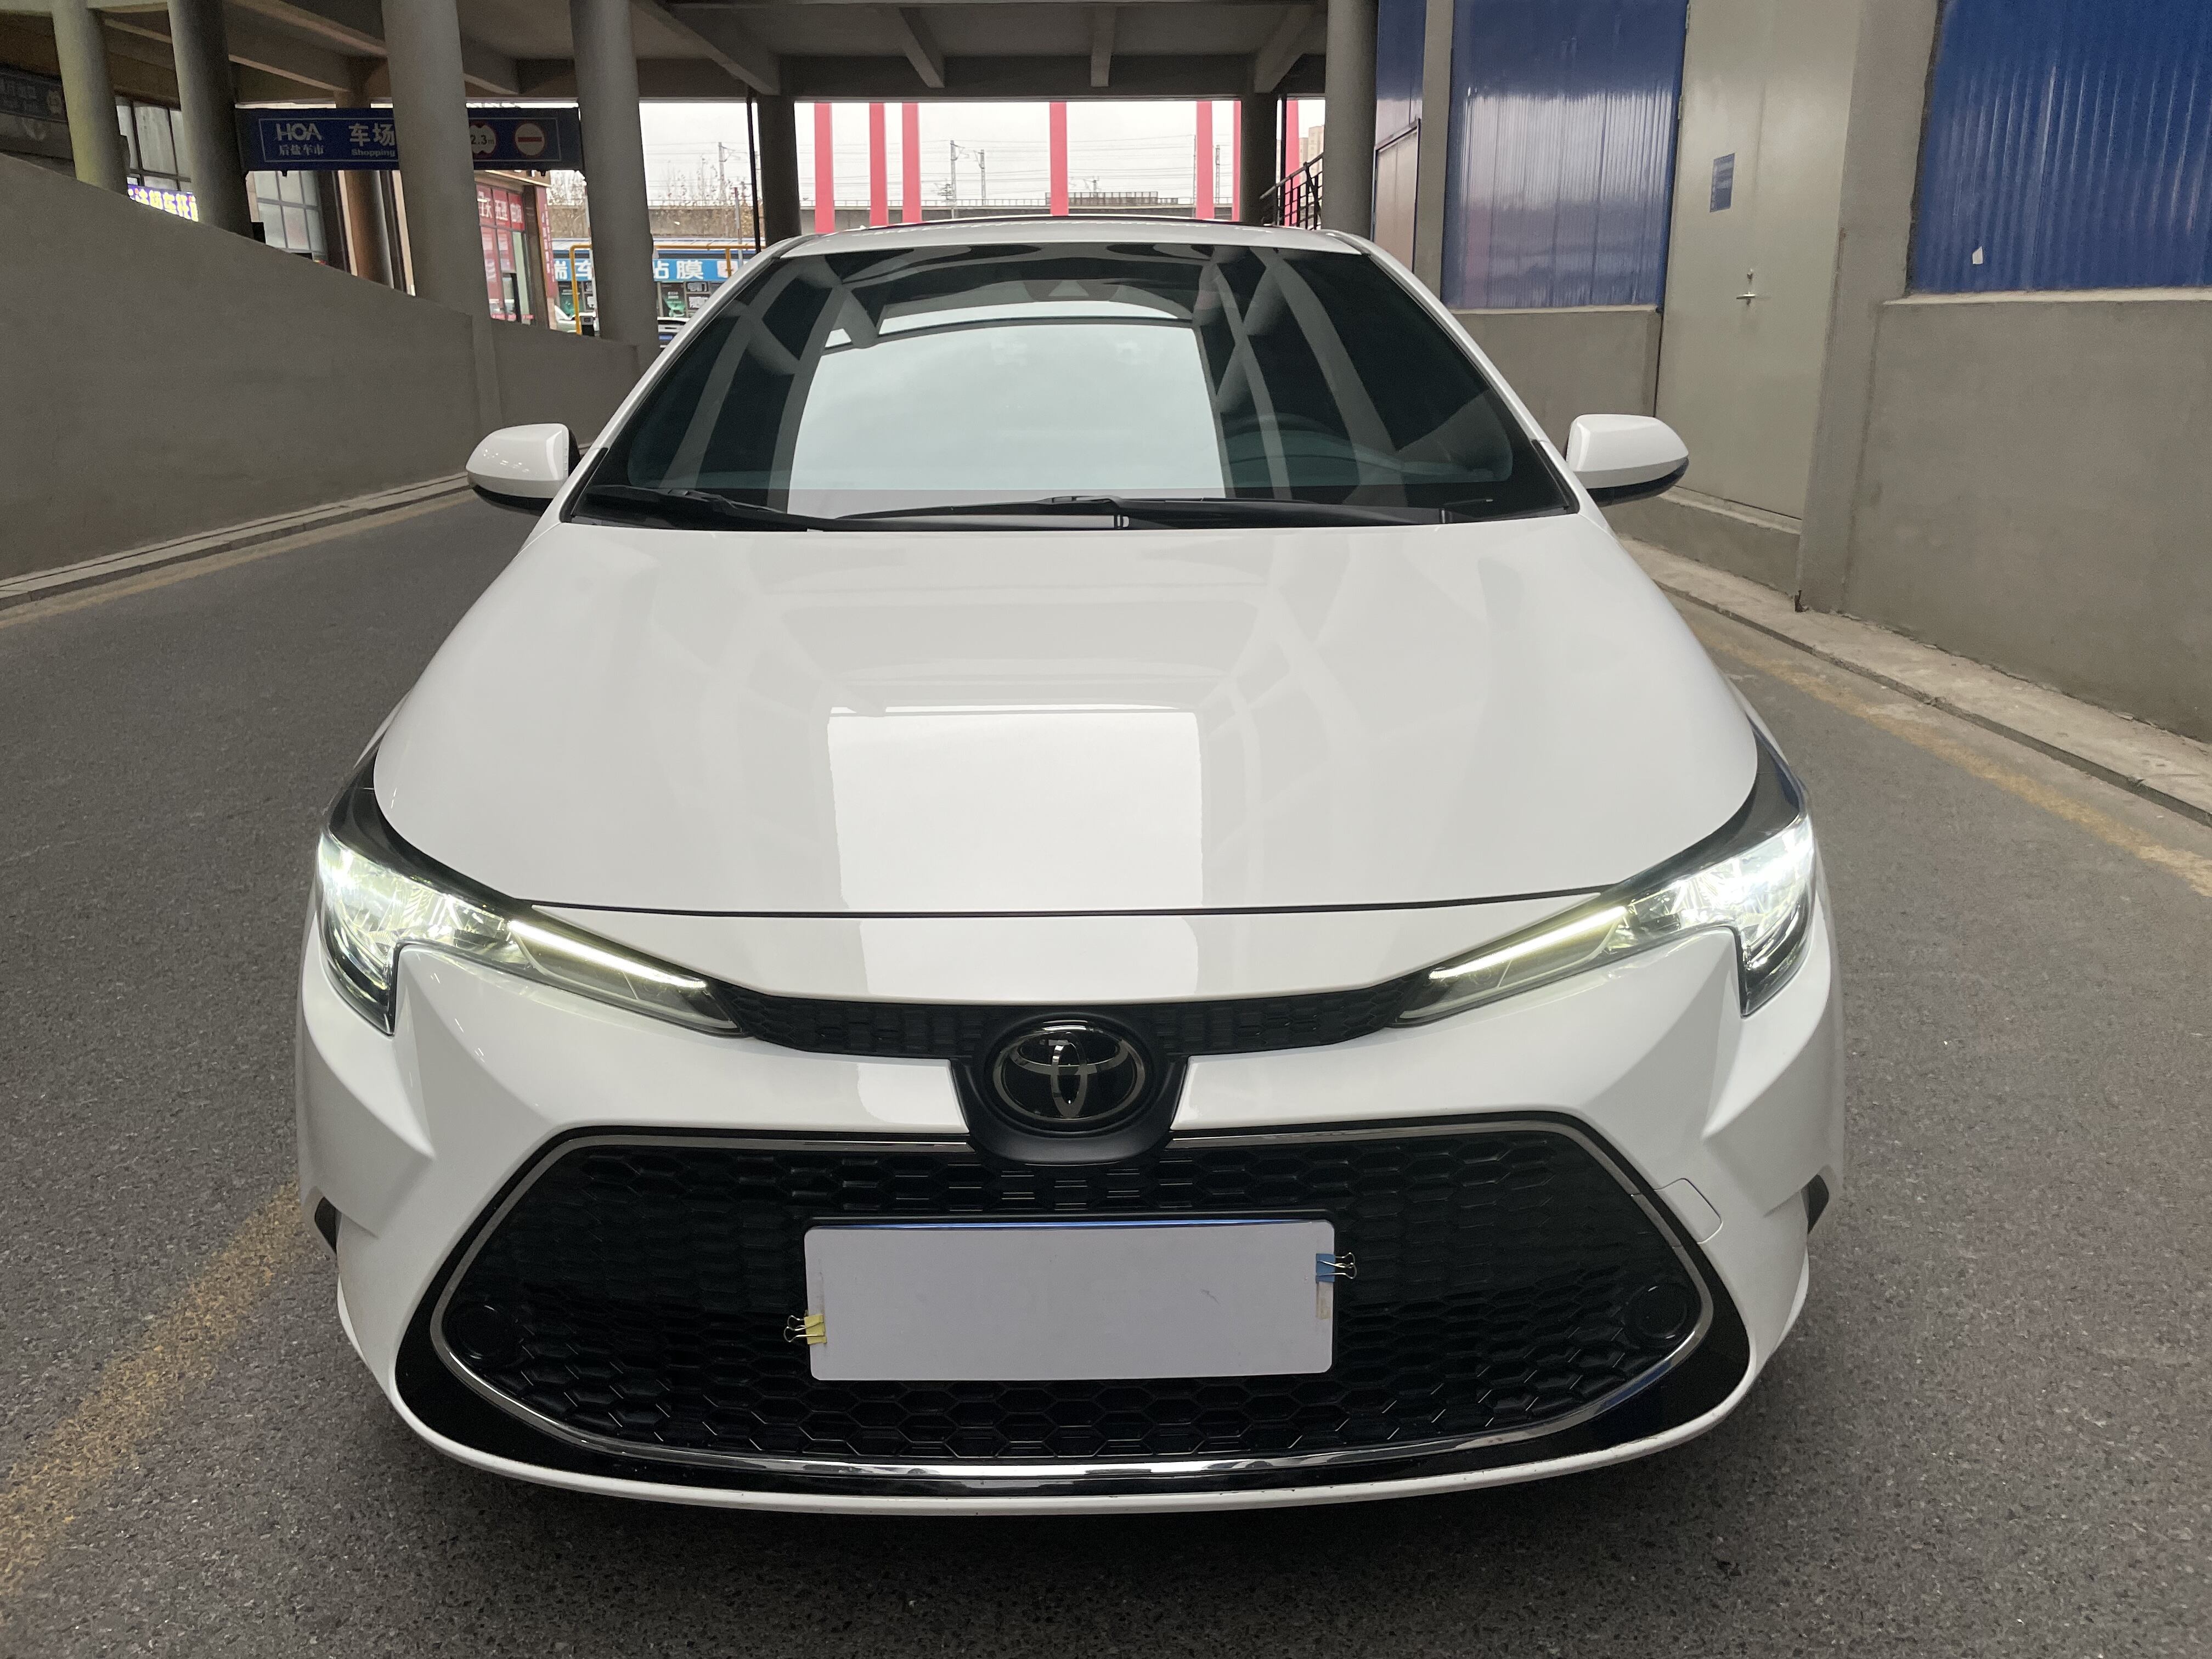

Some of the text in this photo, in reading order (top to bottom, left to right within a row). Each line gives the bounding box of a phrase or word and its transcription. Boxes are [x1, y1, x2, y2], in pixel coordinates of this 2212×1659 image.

[276, 123, 322, 141] HOA
[348, 122, 395, 146] 车场
[351, 149, 395, 157] Shopping
